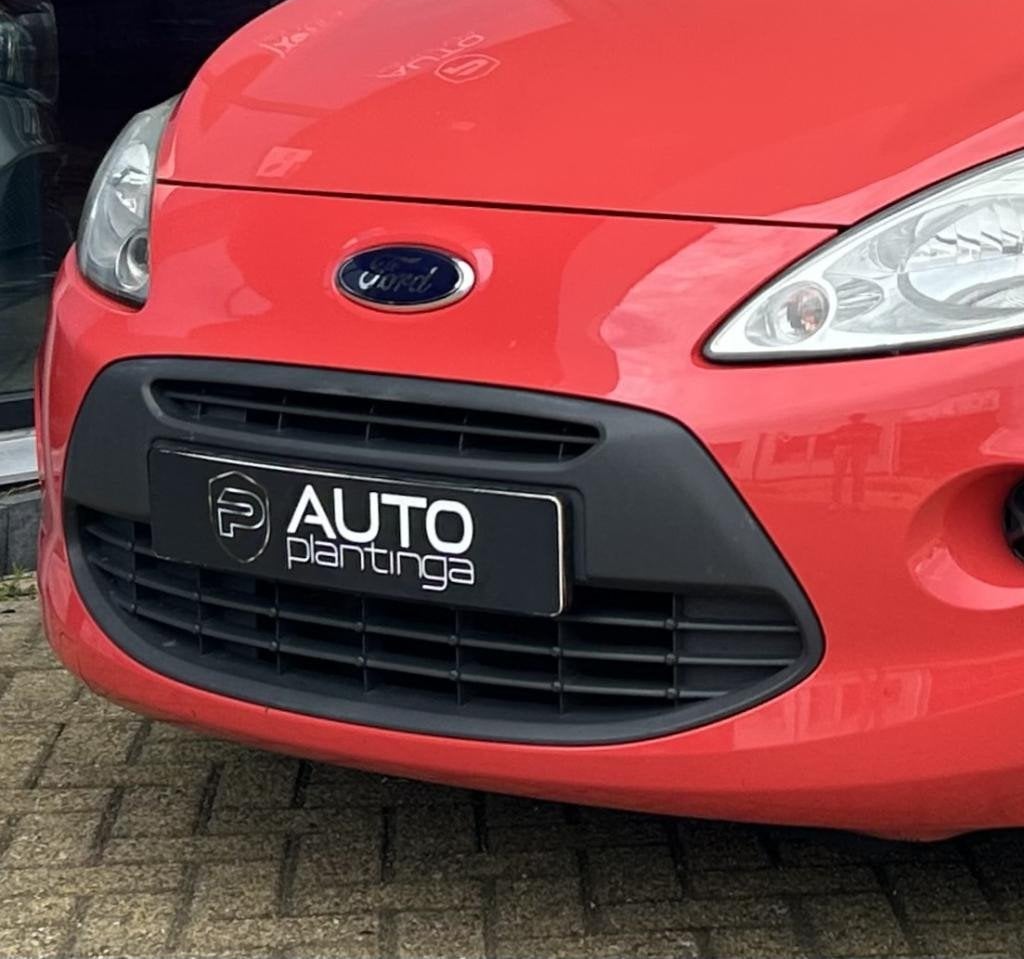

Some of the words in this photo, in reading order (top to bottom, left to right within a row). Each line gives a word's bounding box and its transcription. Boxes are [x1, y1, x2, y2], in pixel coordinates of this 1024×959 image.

[357, 256, 439, 294] Ford
[286, 484, 474, 555] AUTO
[286, 534, 475, 591] plantinga
